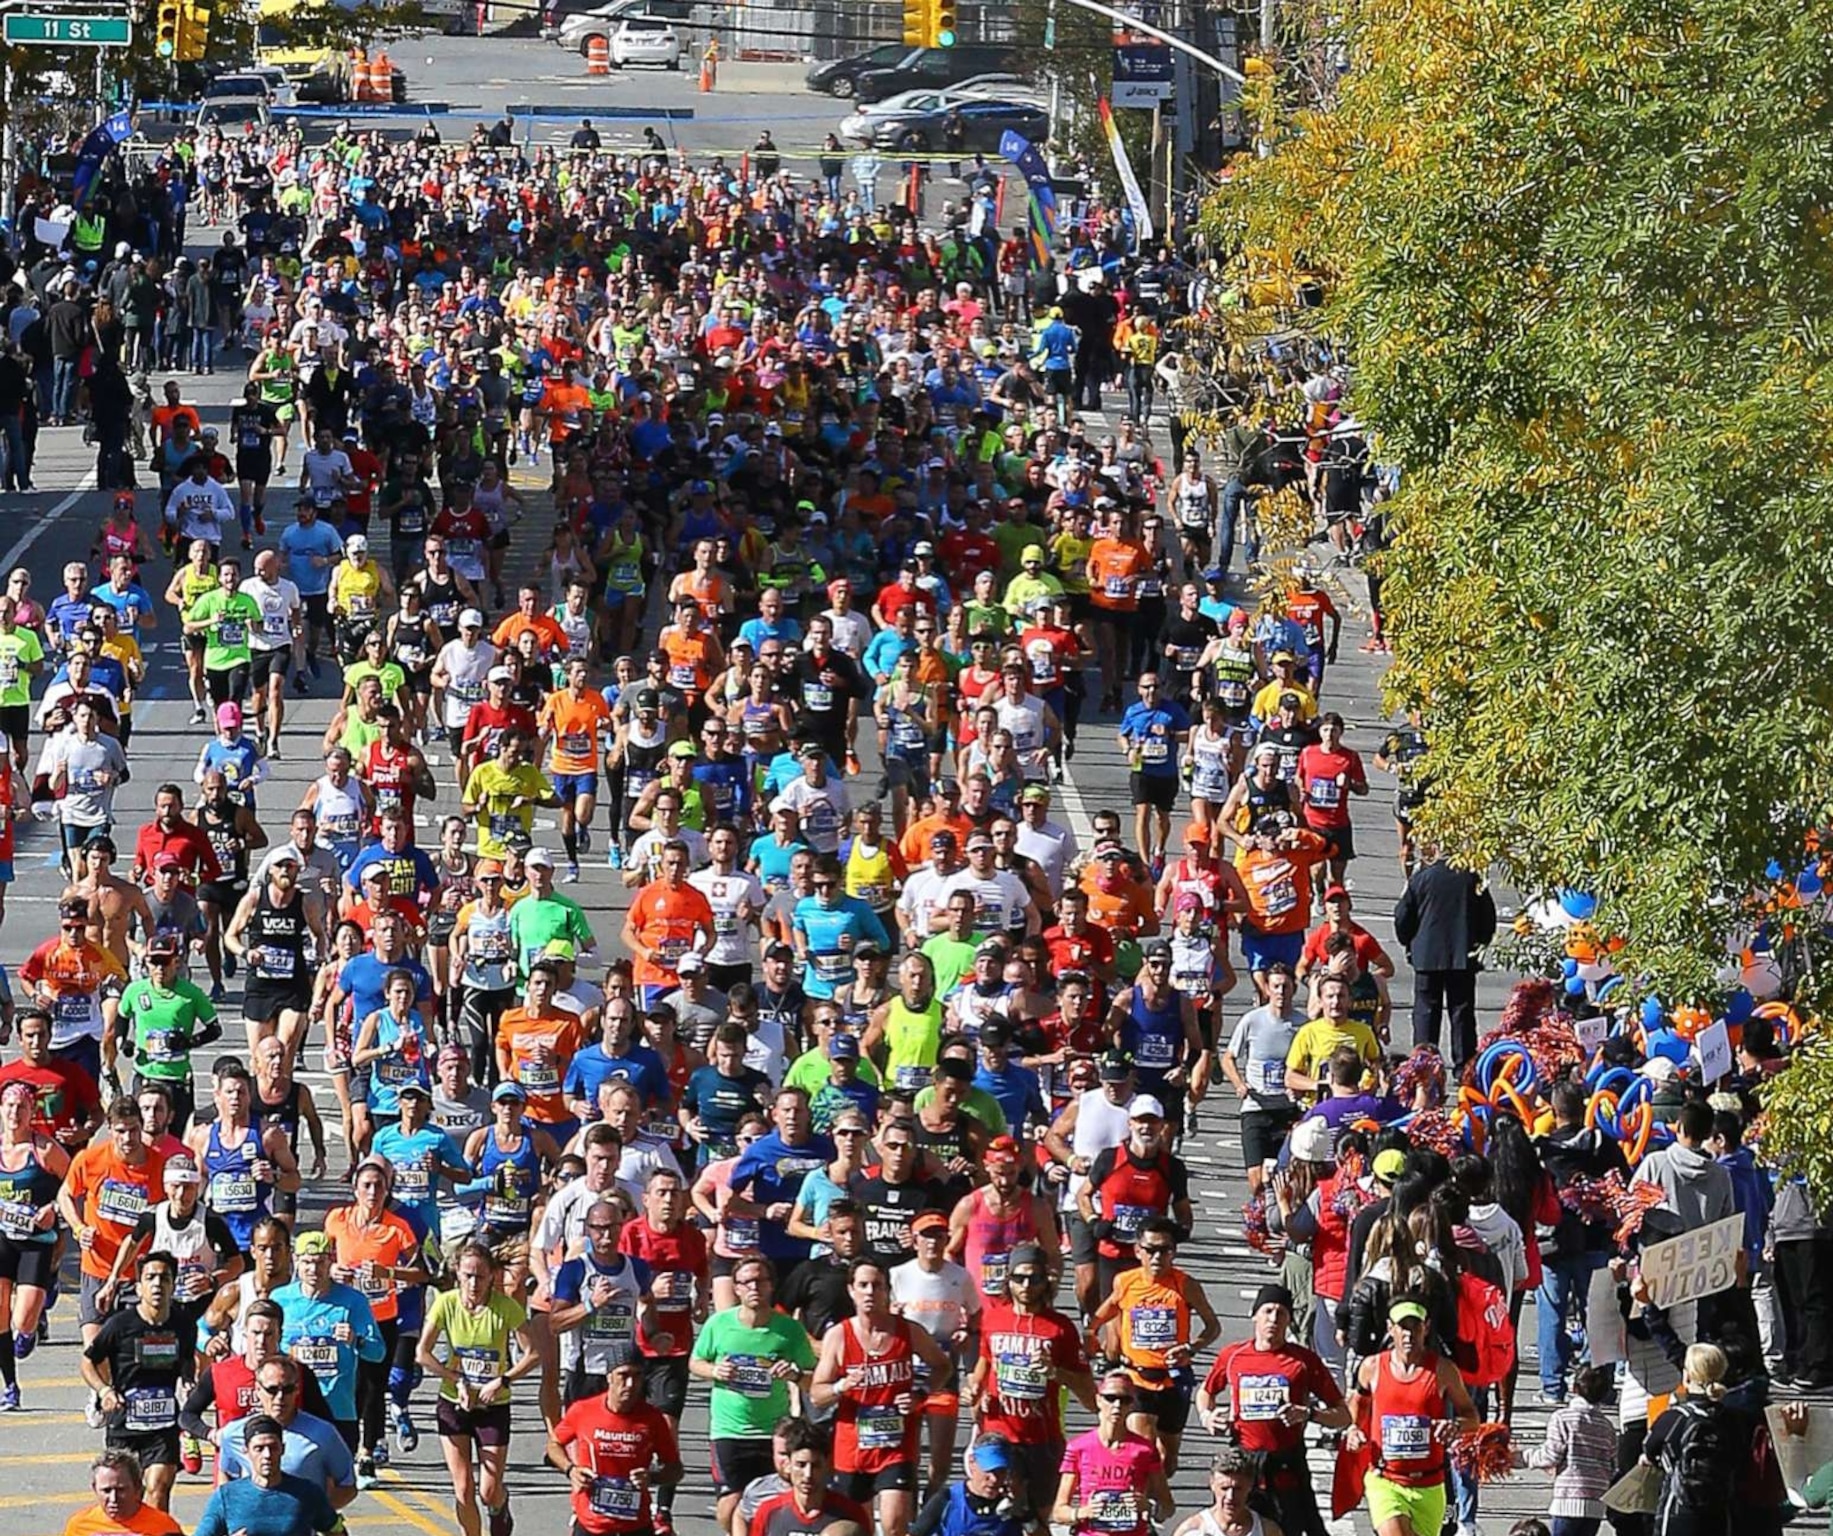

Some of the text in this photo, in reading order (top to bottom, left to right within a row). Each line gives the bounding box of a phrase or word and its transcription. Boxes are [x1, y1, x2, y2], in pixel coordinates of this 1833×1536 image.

[43, 22, 91, 40] 11 St
[262, 917, 296, 930] VOLT
[302, 1349, 332, 1362] 12407
[142, 1400, 168, 1418] 8187
